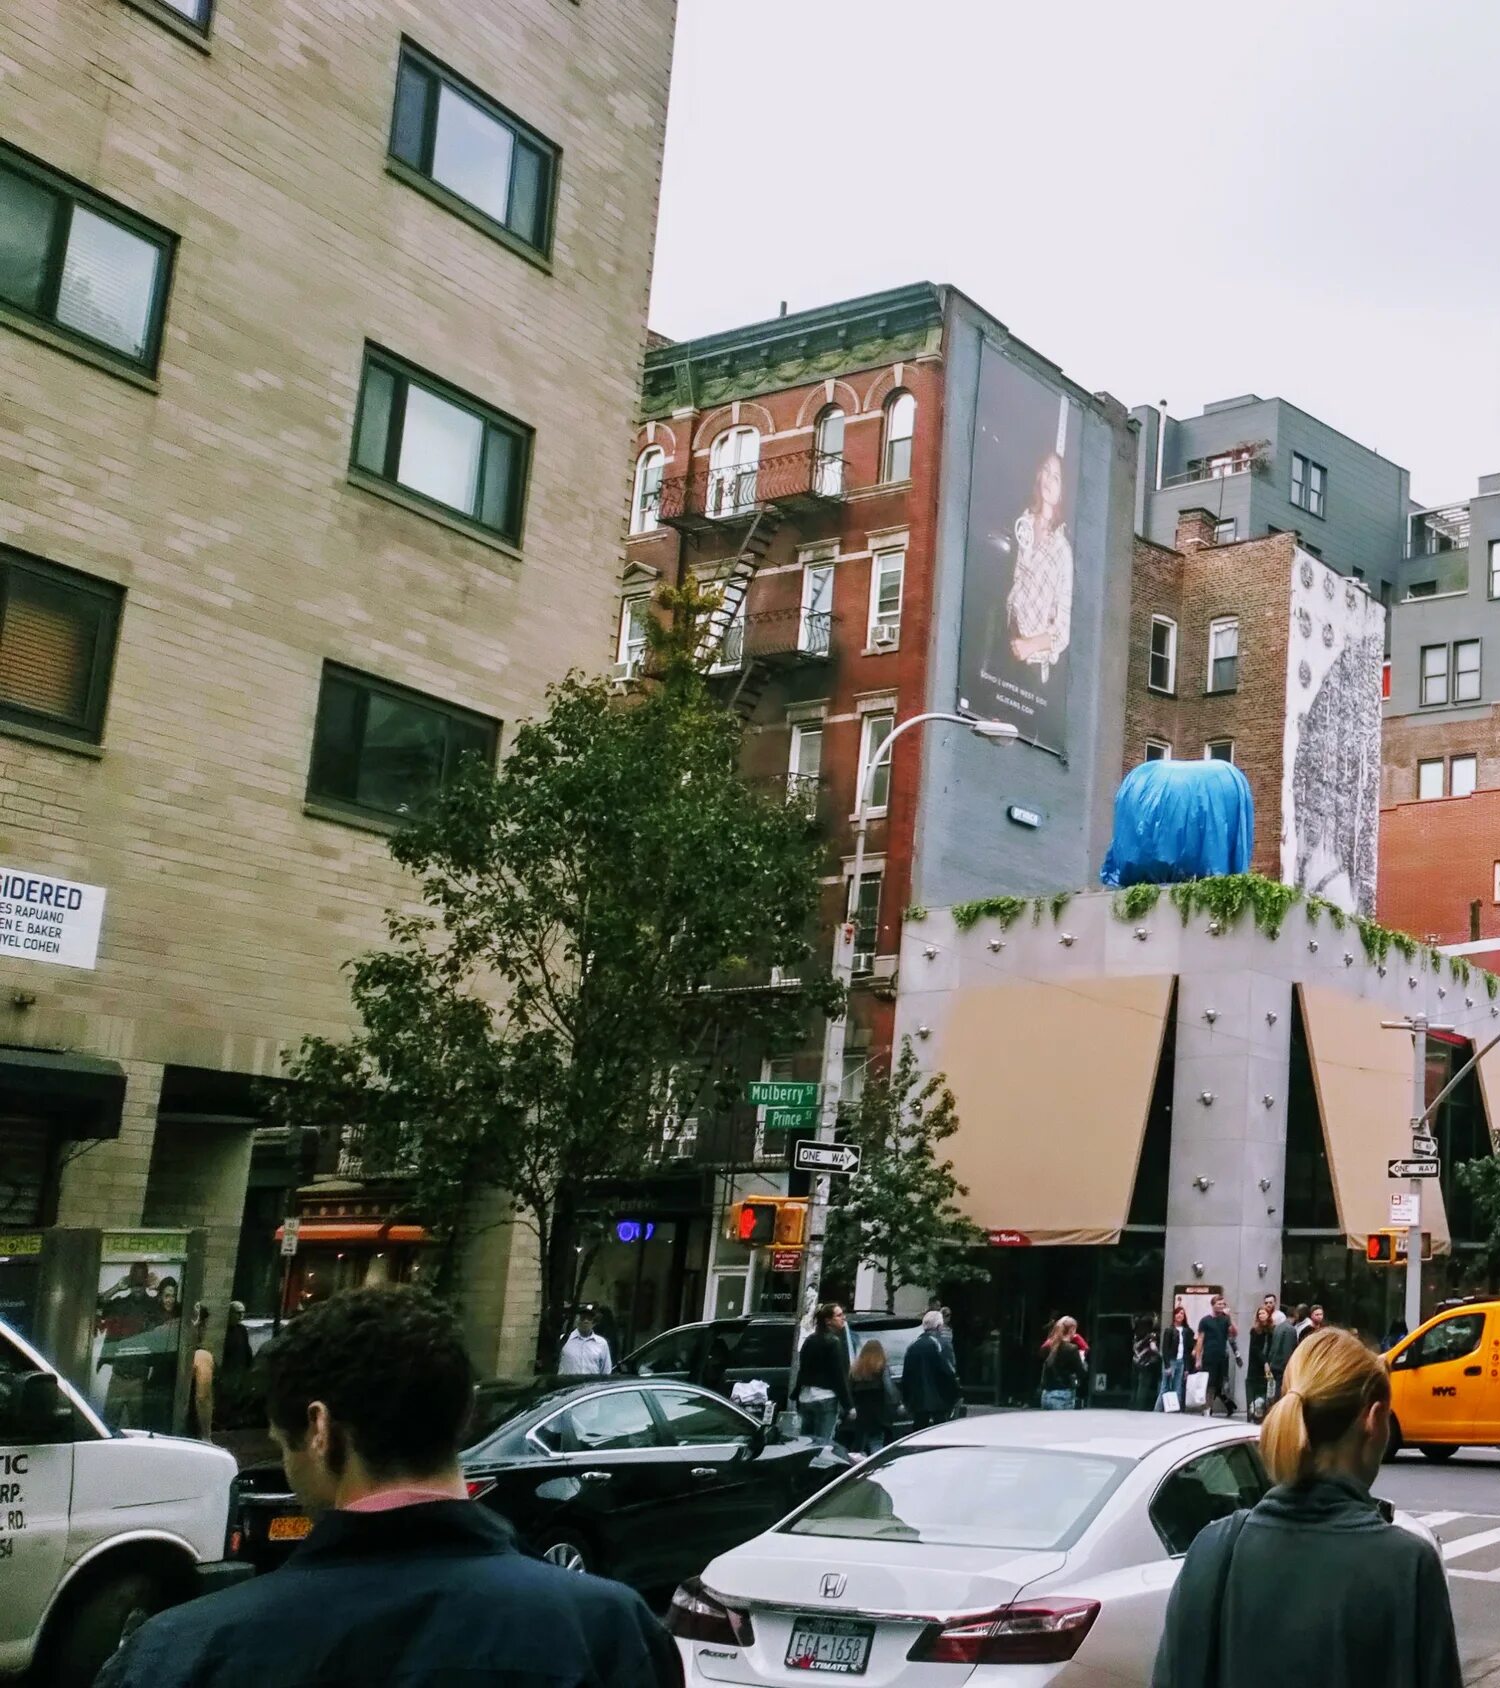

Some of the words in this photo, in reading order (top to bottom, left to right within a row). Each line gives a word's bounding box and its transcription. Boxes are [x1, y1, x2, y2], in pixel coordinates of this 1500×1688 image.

[0, 874, 82, 911] IDERED
[15, 904, 64, 924] RAPUANO
[27, 922, 62, 939] BAKER
[23, 937, 60, 954] COHEN
[751, 1085, 804, 1105] Mulberry
[771, 1111, 802, 1126] Prince
[802, 1150, 821, 1161] ONE
[831, 1152, 851, 1164] WAY
[1394, 1164, 1409, 1173] ONE
[1418, 1164, 1435, 1172] WAY
[1432, 1386, 1457, 1397] NYC
[698, 1649, 738, 1660] Accord
